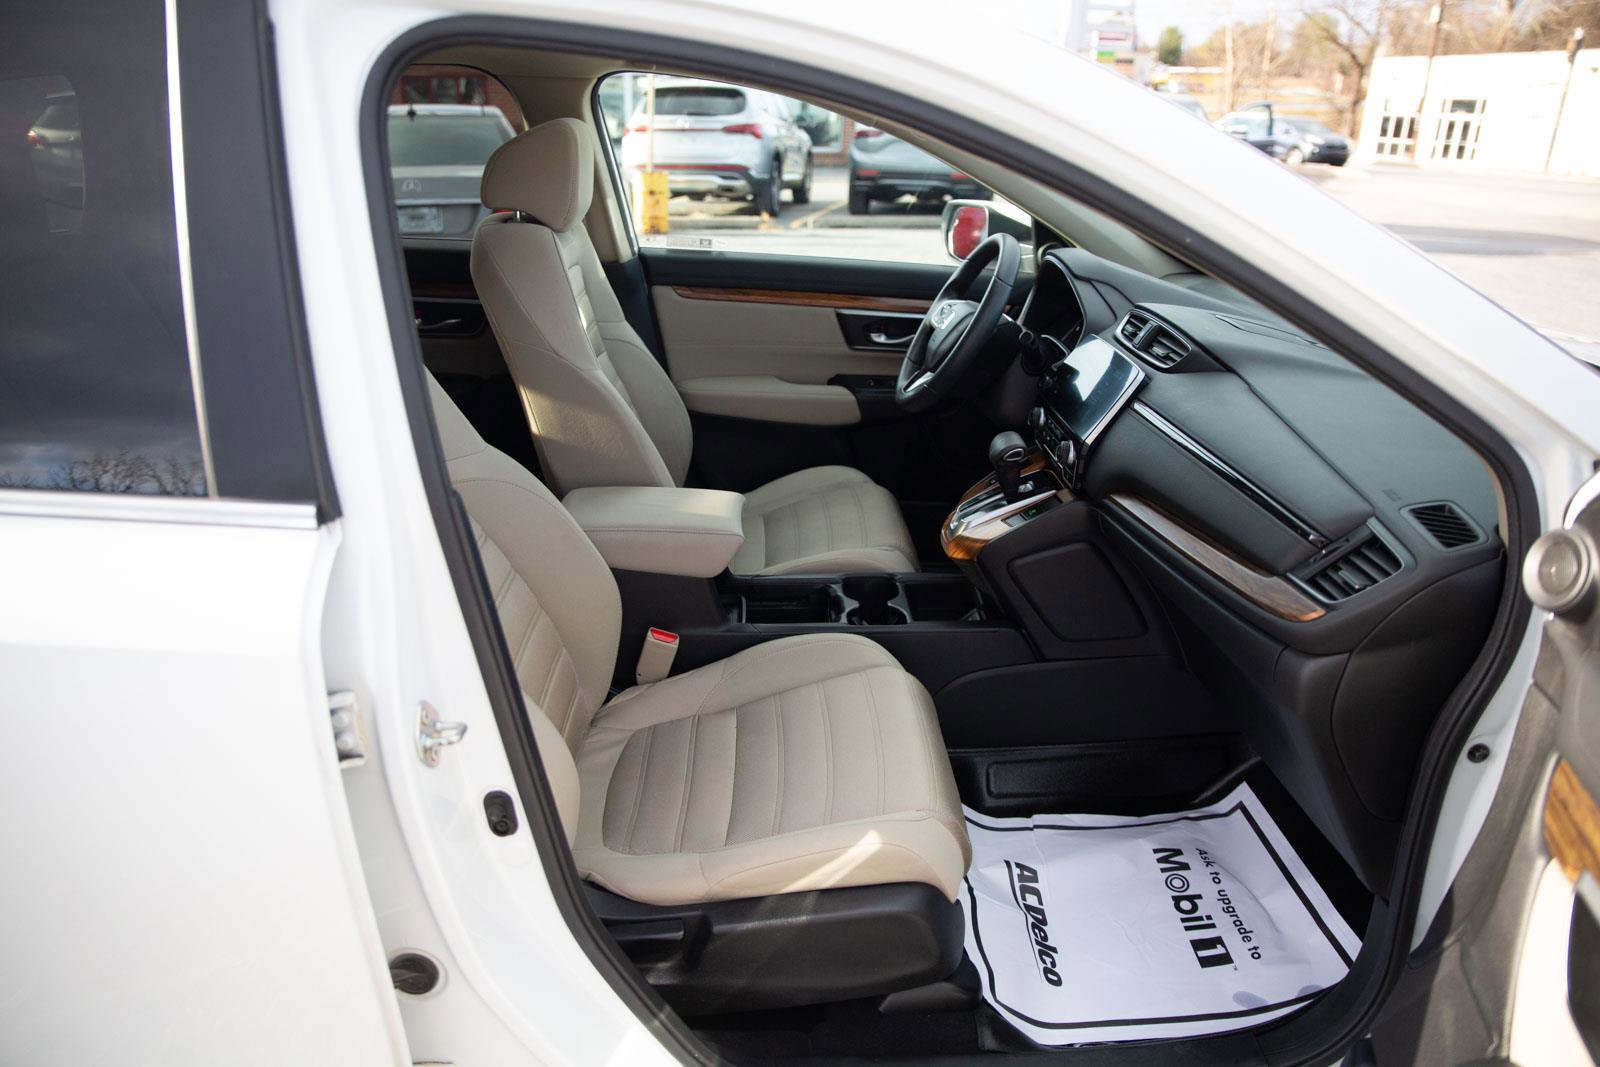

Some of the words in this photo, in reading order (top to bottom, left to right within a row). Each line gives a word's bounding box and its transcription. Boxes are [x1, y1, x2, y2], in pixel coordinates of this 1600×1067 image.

[1014, 861, 1063, 987] ACDelco
[1152, 847, 1217, 932] Mobil
[1195, 848, 1217, 868] Ask
[1209, 871, 1222, 885] to
[1217, 889, 1254, 943] upgrade
[1247, 945, 1262, 960] to
